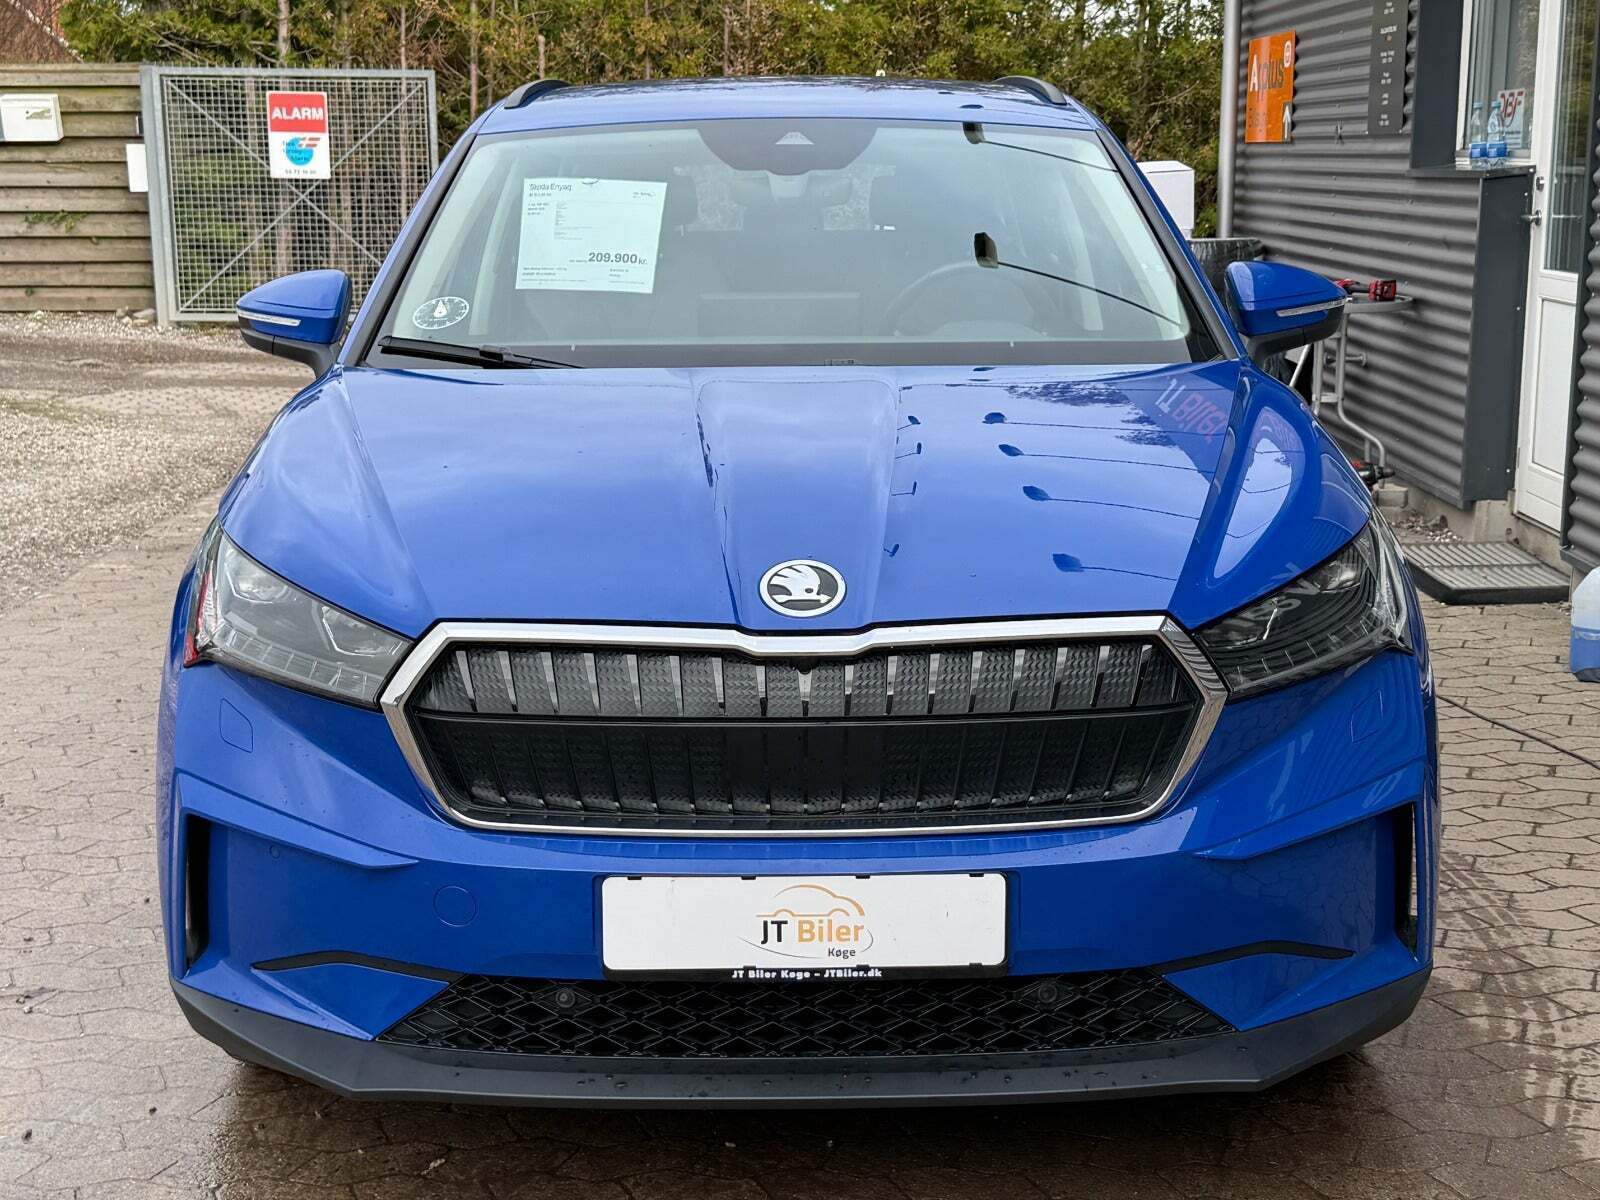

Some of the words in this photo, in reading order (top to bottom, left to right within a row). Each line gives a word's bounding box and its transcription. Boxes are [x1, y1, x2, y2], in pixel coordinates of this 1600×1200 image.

[272, 107, 323, 120] ALARM
[588, 252, 638, 264] 209.900
[761, 920, 788, 944] JT
[797, 919, 864, 943] Biler
[828, 947, 856, 960] Køge
[731, 970, 744, 979] JT
[748, 970, 777, 979] Biler
[823, 968, 883, 978] JTBiler.dk
